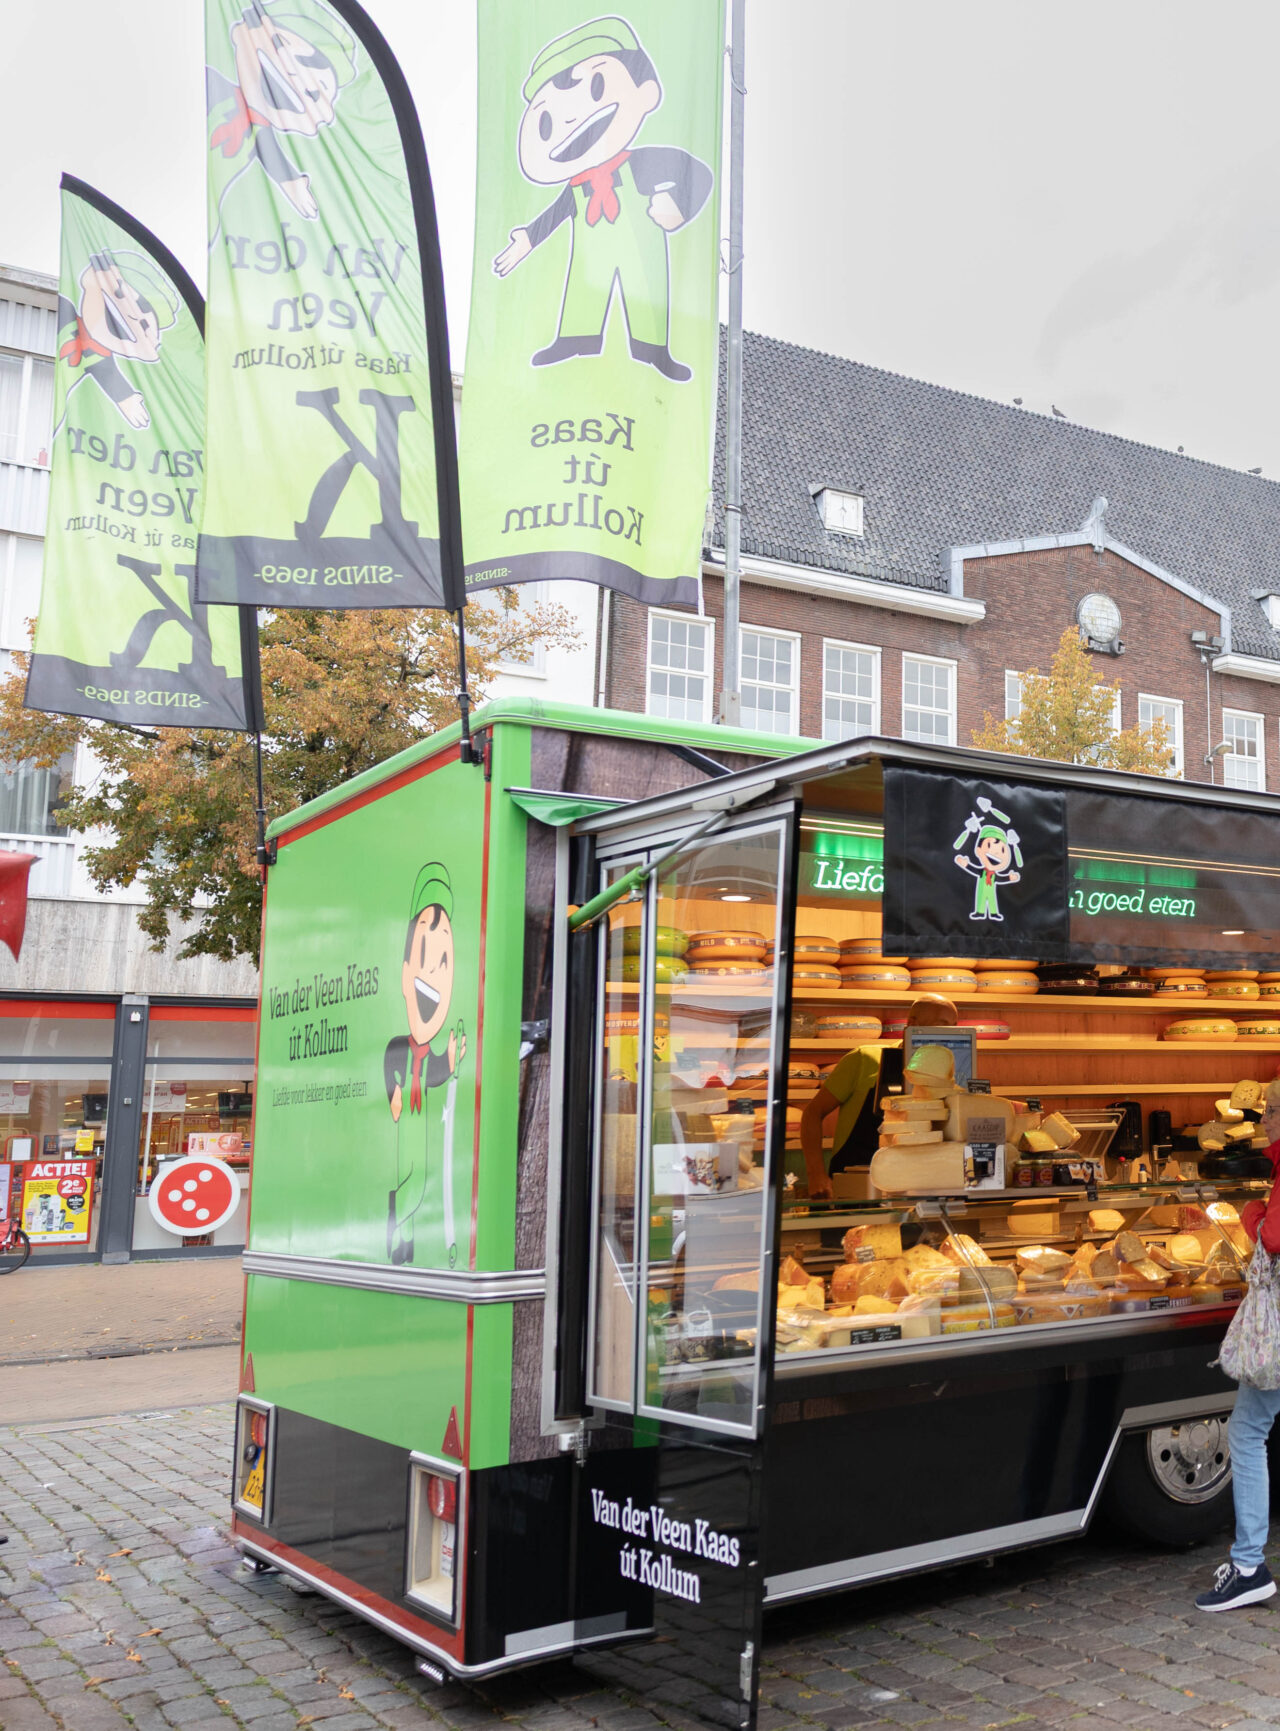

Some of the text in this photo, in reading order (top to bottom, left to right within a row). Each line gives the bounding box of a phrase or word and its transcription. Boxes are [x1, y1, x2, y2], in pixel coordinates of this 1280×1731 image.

[1085, 889, 1146, 915] goed
[1149, 895, 1196, 917] eten
[269, 963, 379, 1020] Van der Veen Kaas
[303, 1018, 348, 1059] Kollum
[31, 1162, 88, 1177] ACTIE!
[591, 1488, 740, 1567] Van der Veen Kaas
[620, 1542, 701, 1604] út Kollum
